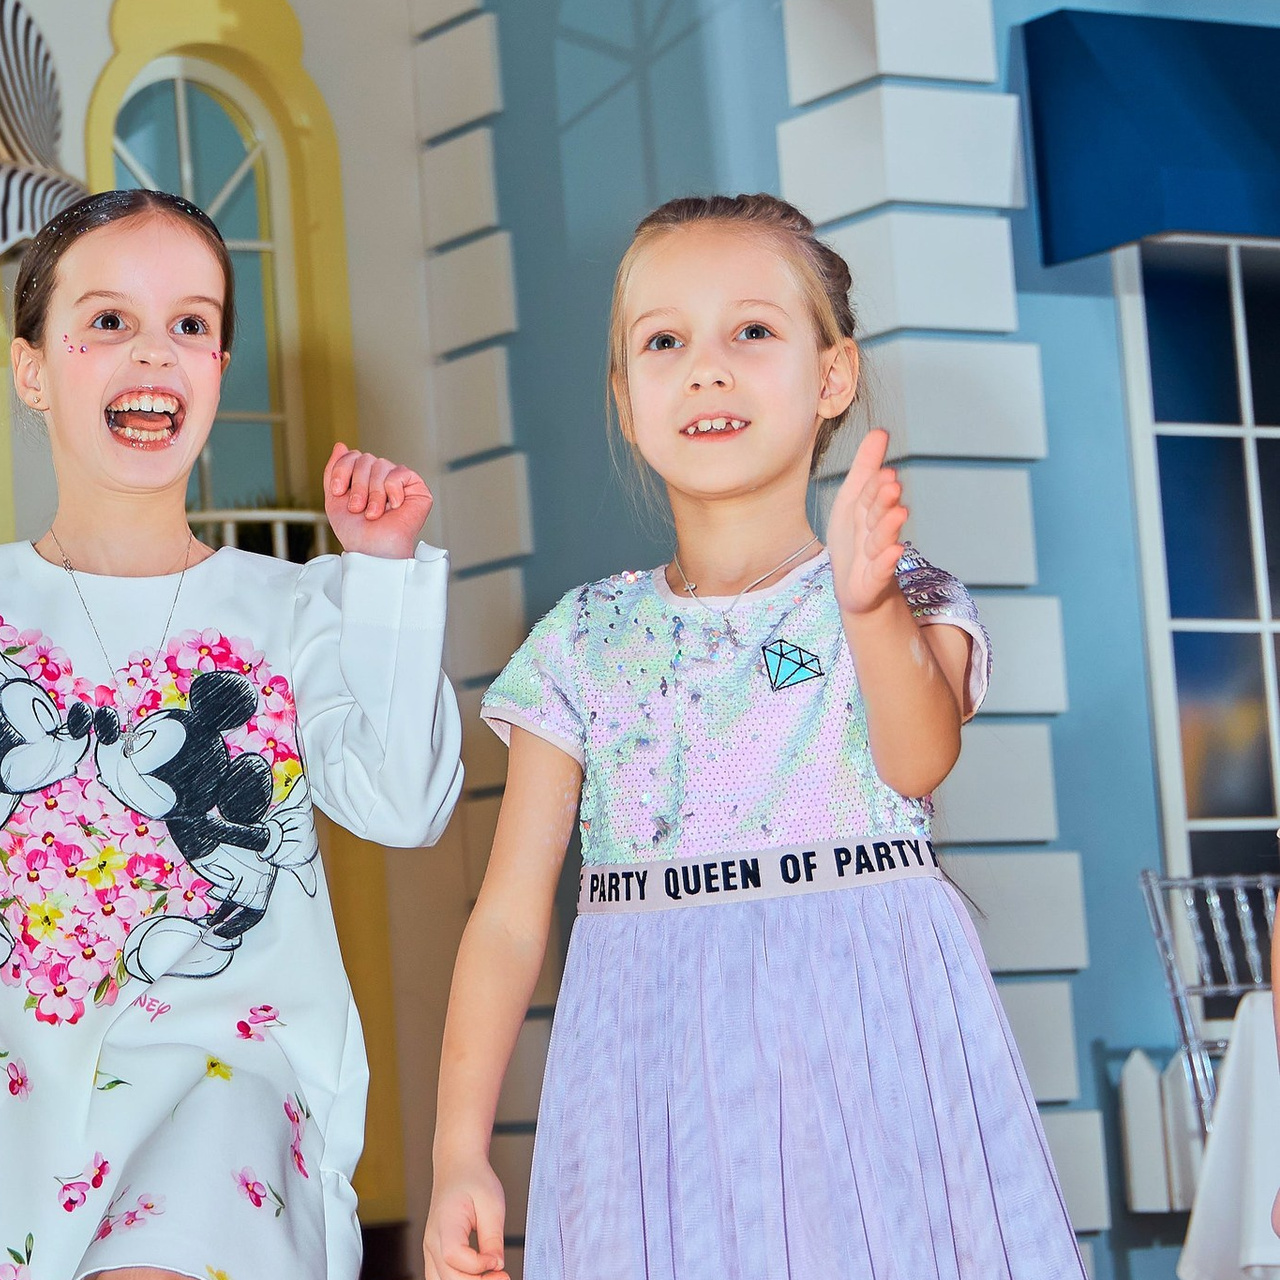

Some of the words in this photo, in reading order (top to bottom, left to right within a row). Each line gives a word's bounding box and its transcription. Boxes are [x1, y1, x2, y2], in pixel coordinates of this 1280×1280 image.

[589, 870, 648, 903] PARTY
[664, 858, 761, 901] QUEEN
[780, 851, 817, 885] OF
[834, 839, 925, 878] PARTY
